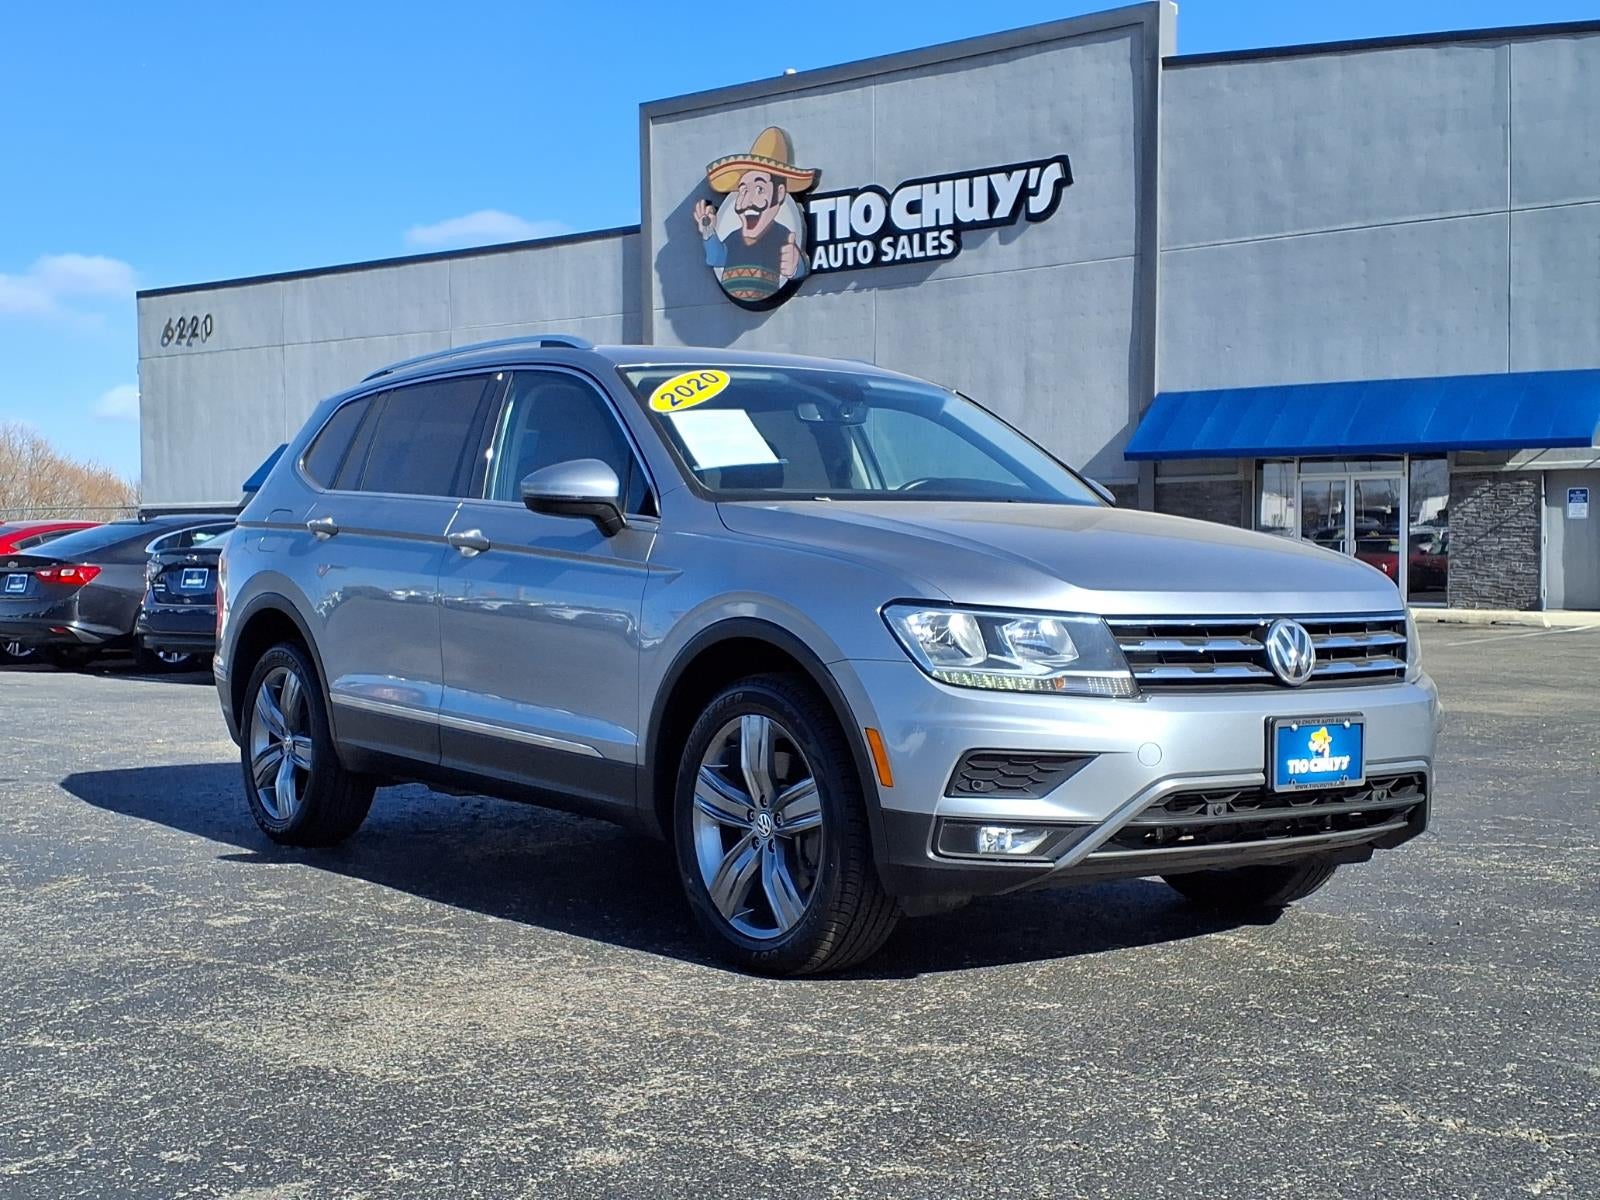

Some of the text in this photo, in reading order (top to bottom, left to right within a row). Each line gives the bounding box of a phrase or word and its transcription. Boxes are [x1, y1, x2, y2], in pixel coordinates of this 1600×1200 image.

[809, 162, 1064, 241] TIO CHUY'S
[812, 230, 956, 270] AUTO SALES
[161, 313, 213, 346] 6220
[661, 373, 719, 406] 2020
[1287, 758, 1309, 775] TIO
